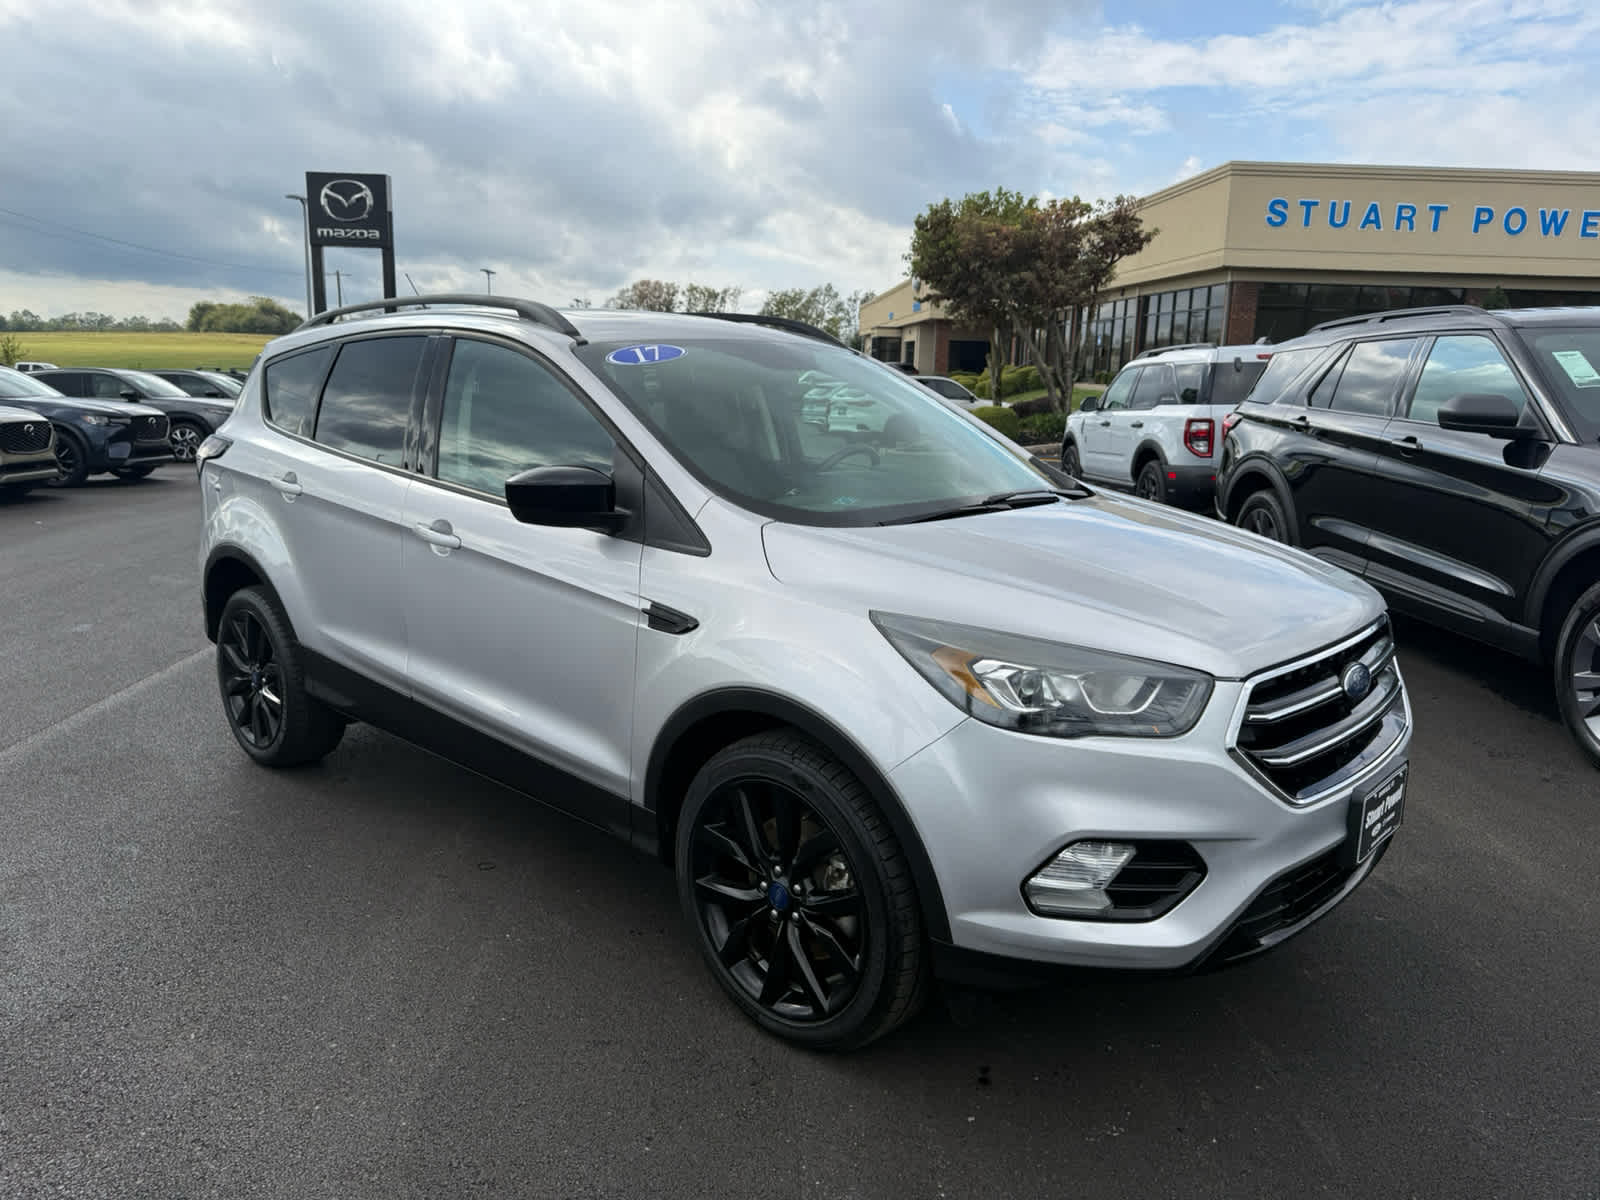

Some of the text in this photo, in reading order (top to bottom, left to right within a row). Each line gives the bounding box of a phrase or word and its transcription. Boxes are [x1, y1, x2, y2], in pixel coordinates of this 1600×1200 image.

[1266, 198, 1600, 238] STUART POWE
[630, 345, 659, 362] 17
